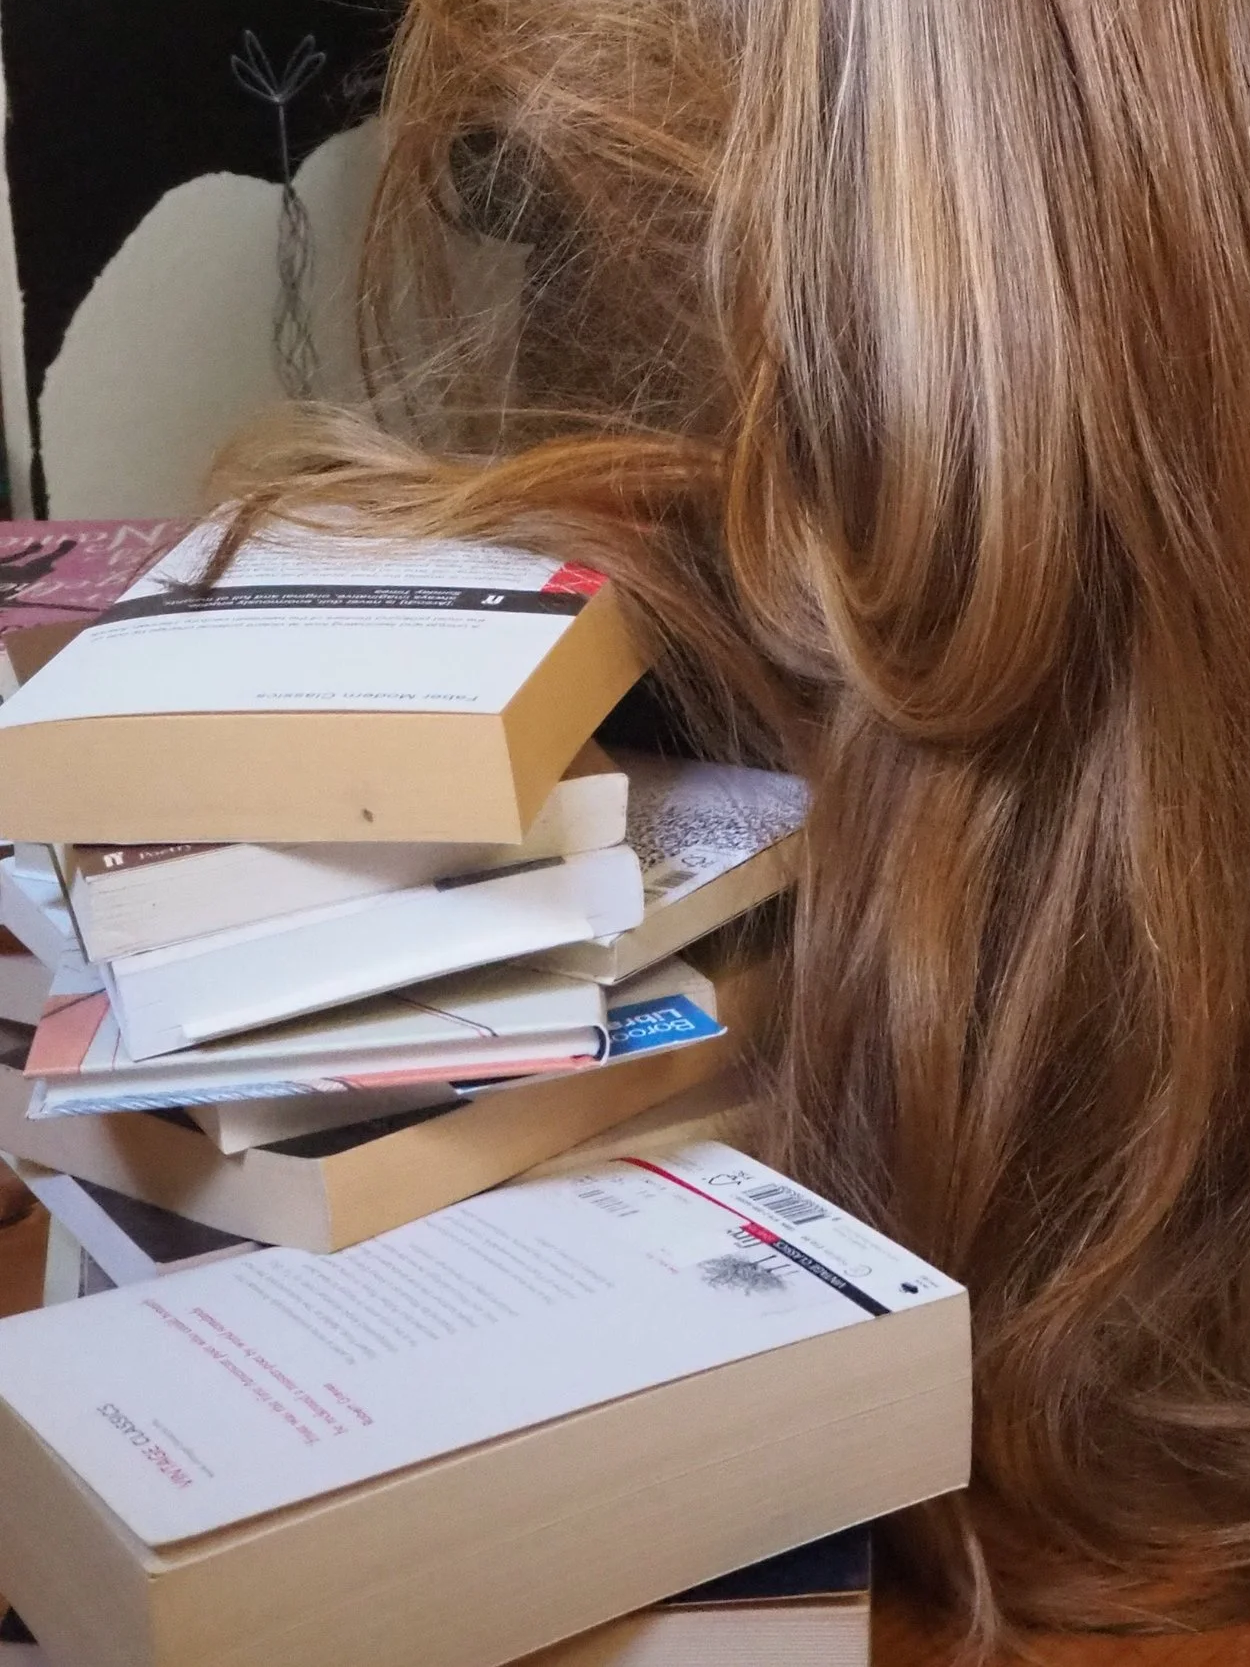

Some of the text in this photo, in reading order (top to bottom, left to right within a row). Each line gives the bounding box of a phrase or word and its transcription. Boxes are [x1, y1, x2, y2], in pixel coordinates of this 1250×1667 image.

[256, 692, 480, 702] Faber Modern Classics
[609, 1019, 696, 1043] Boroo
[92, 1401, 153, 1446] CLASSICS
[137, 1444, 198, 1489] VINTAGE
